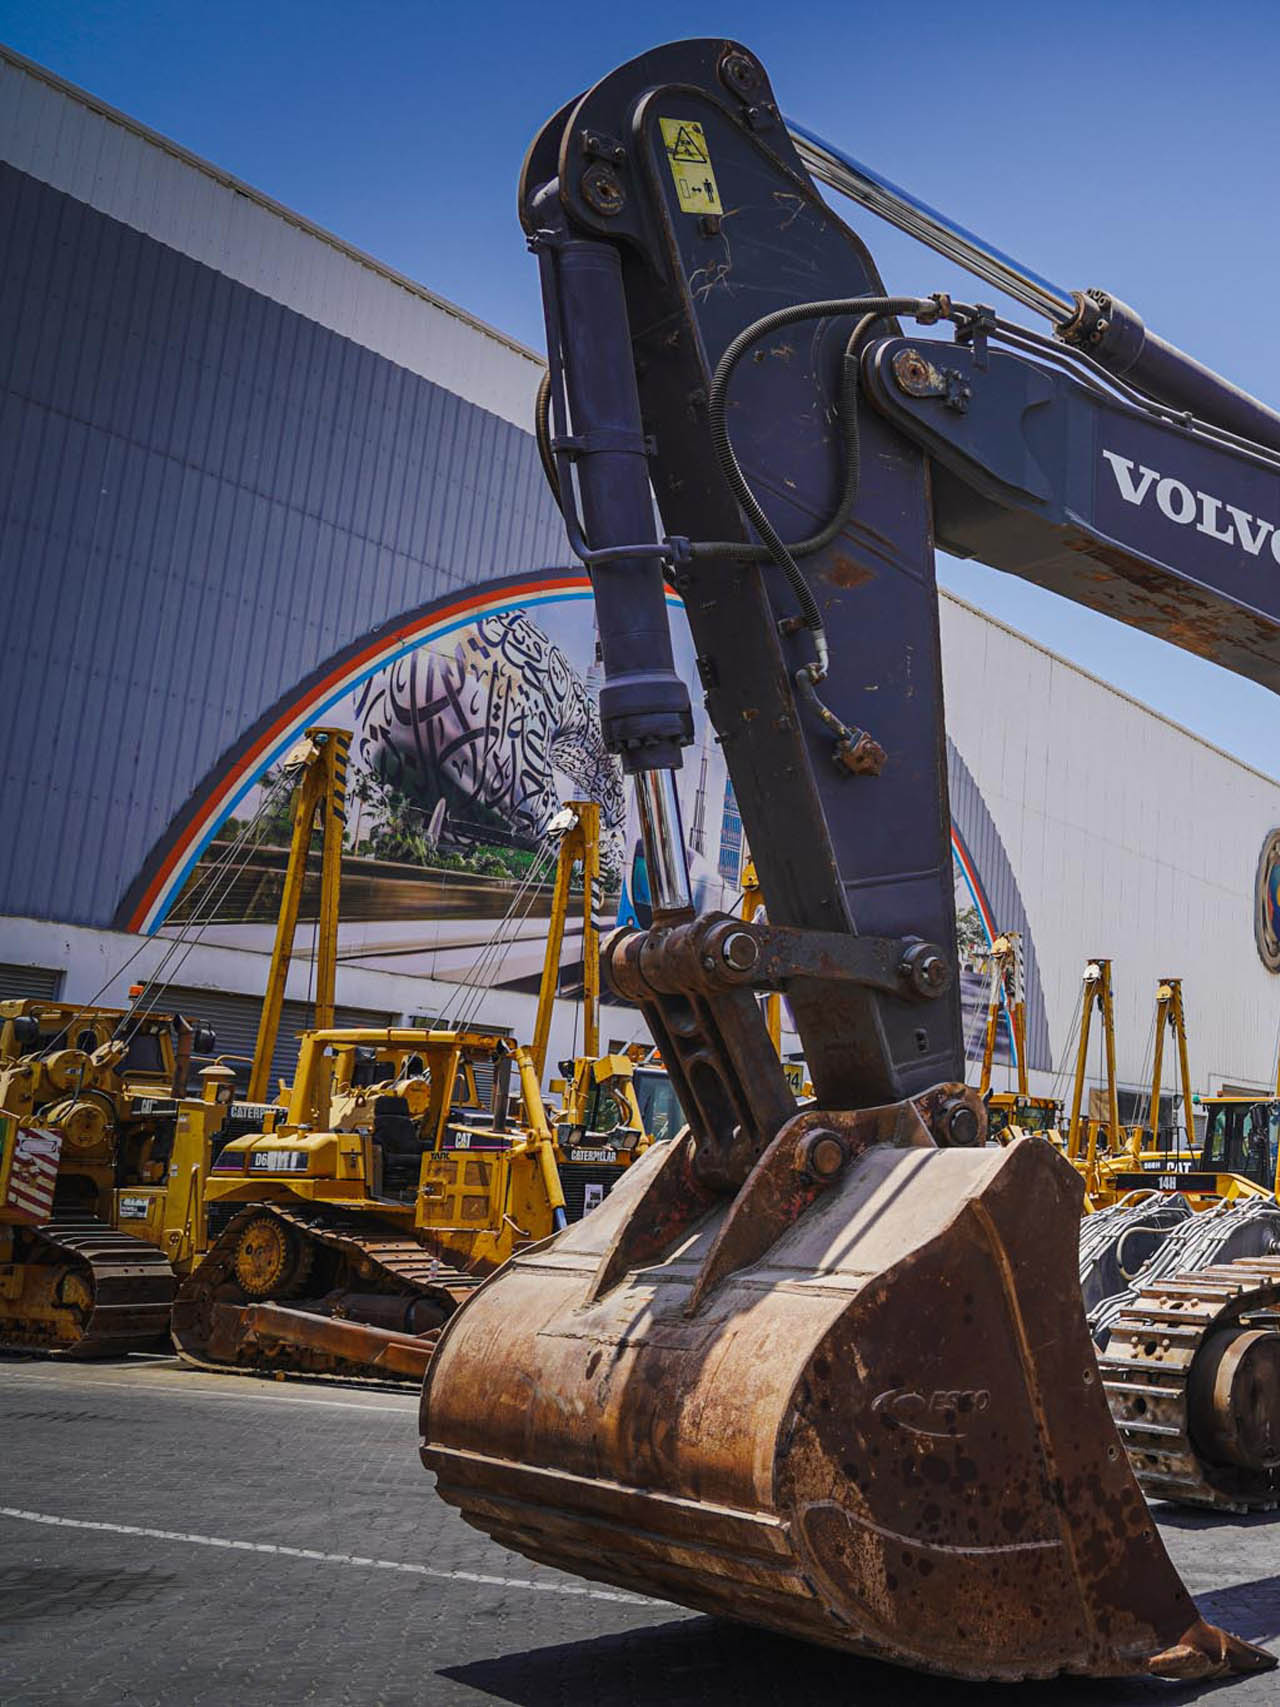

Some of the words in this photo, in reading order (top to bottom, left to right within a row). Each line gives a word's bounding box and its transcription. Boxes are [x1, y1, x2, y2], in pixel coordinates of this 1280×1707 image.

[455, 1132, 472, 1149] CAT
[571, 1150, 616, 1162] CATERPILLAR
[1167, 1162, 1191, 1174] CAT
[1159, 1176, 1177, 1190] 14H
